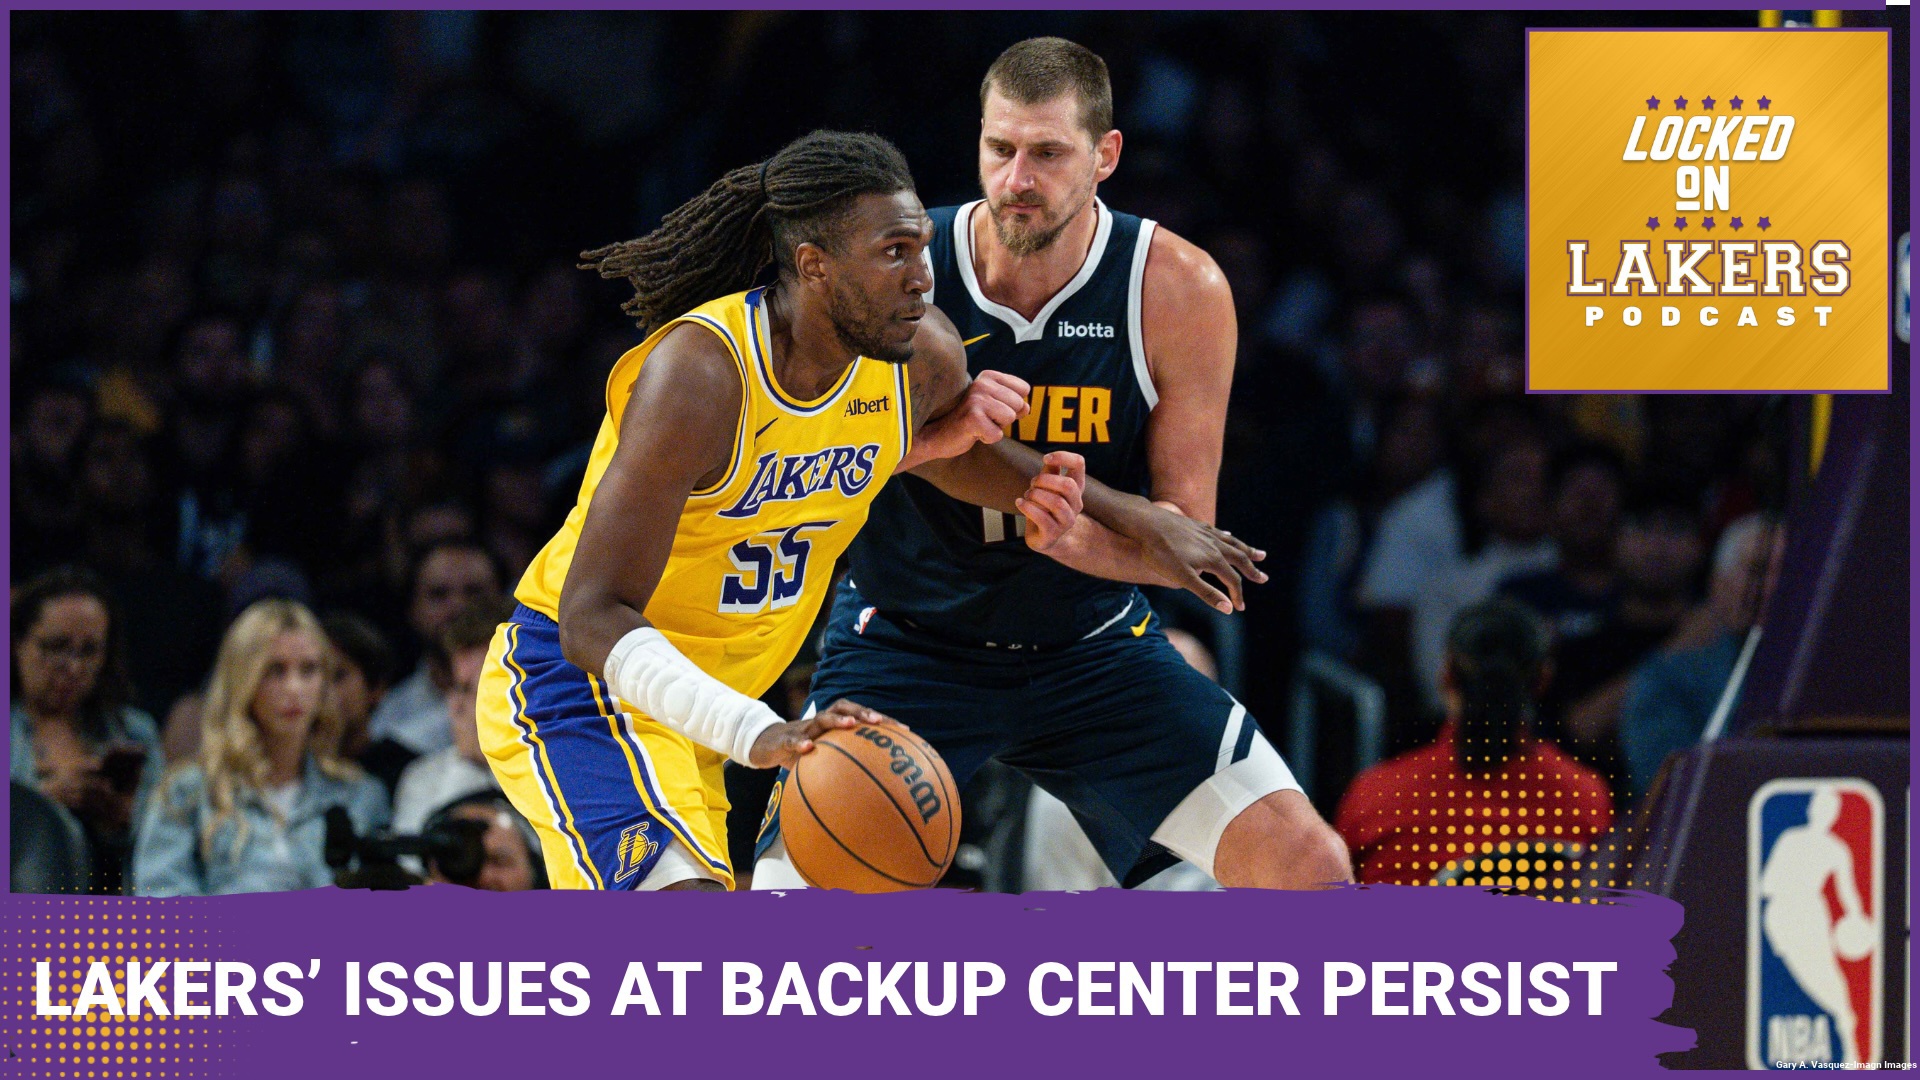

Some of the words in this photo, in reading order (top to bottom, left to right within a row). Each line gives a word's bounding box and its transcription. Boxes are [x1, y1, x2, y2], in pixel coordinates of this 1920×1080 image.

[1058, 321, 1115, 338] ibotta
[843, 395, 890, 418] Albert
[1003, 385, 1112, 443] VER
[715, 443, 881, 518] LAKERS
[717, 520, 841, 614] 55
[854, 726, 942, 826] Wilson
[1767, 1014, 1833, 1064] NBA
